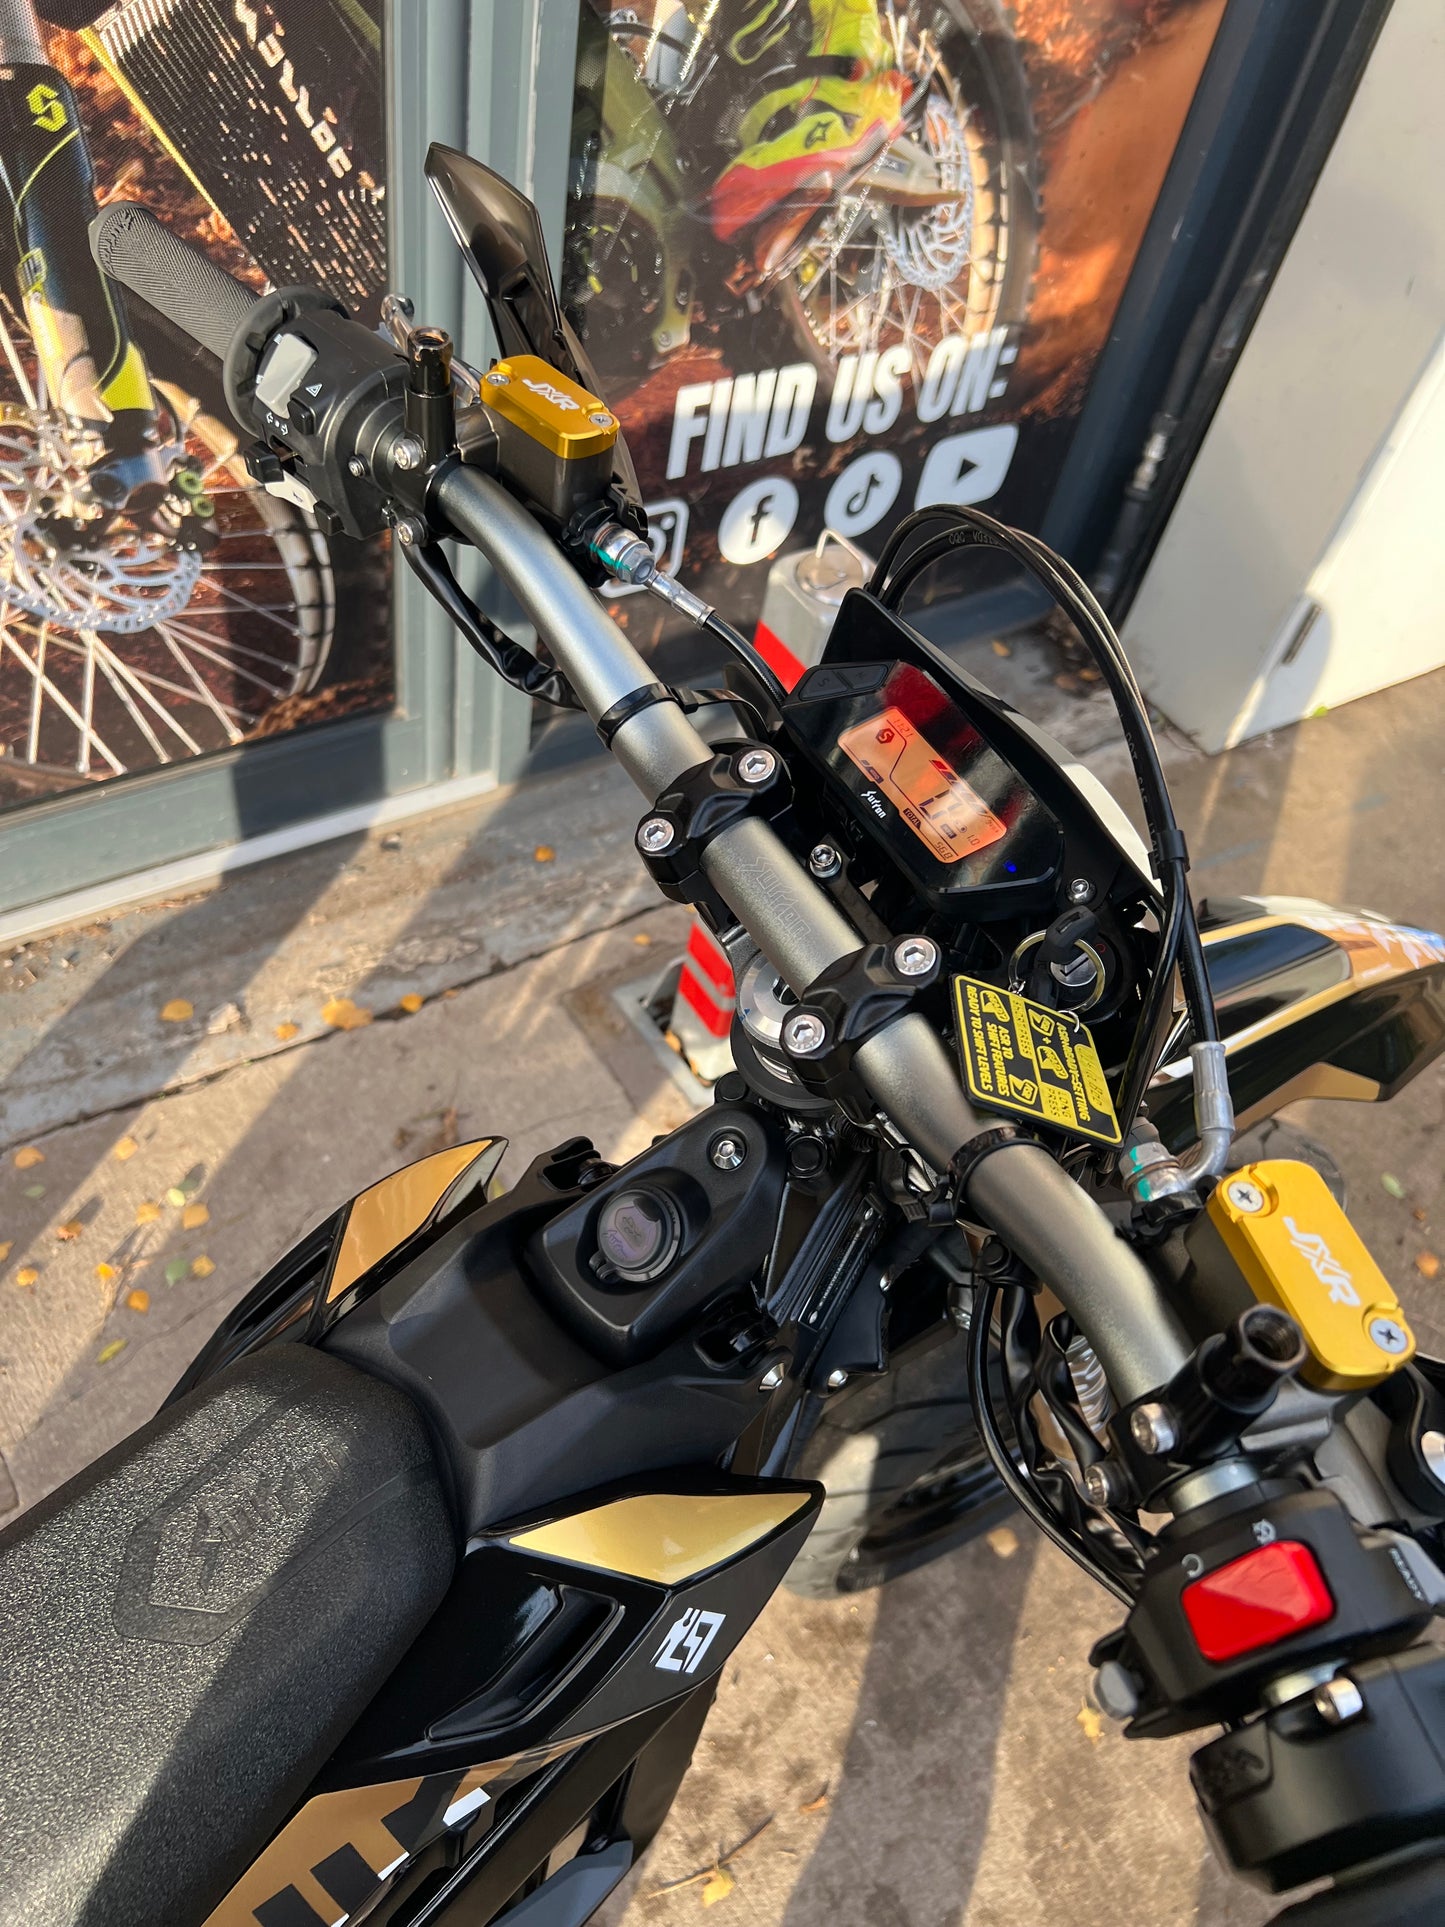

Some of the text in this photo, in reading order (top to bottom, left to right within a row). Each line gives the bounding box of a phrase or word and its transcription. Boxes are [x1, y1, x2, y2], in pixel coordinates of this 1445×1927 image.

[666, 327, 1019, 480] FIND US ON:
[903, 808, 919, 827] TOTAL
[966, 984, 993, 1092] READY TO SHIFT LEVELS
[986, 1021, 1010, 1097] SHIFT FEATURES
[997, 1025, 1014, 1060] ASR TO
[1047, 1087, 1061, 1117] PRESS
